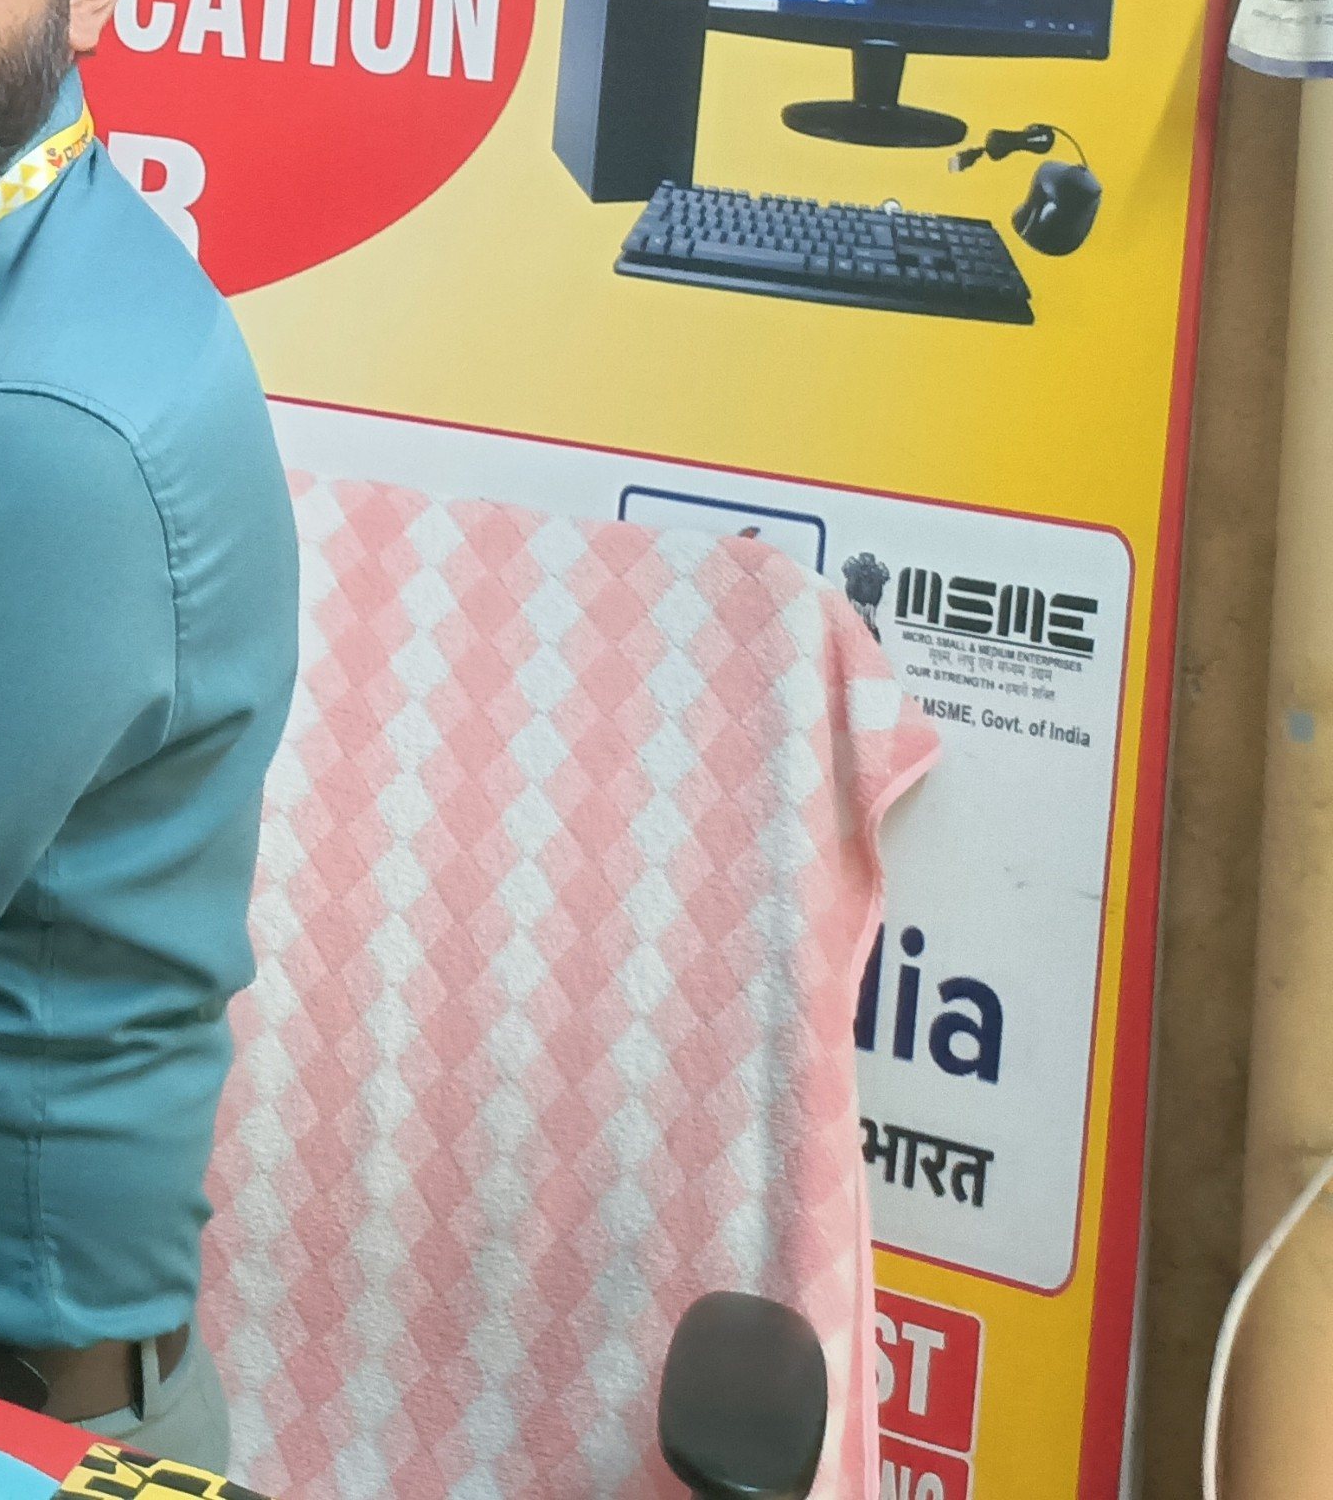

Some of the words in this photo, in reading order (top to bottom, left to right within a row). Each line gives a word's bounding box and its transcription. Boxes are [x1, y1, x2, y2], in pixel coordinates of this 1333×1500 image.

[895, 566, 1098, 653] MSME
[936, 637, 966, 652] SMALL
[906, 664, 930, 677] OUR
[934, 668, 995, 690] STRENGTH
[981, 709, 1024, 734] Govt.
[1029, 720, 1046, 737] of
[1050, 722, 1091, 748] India
